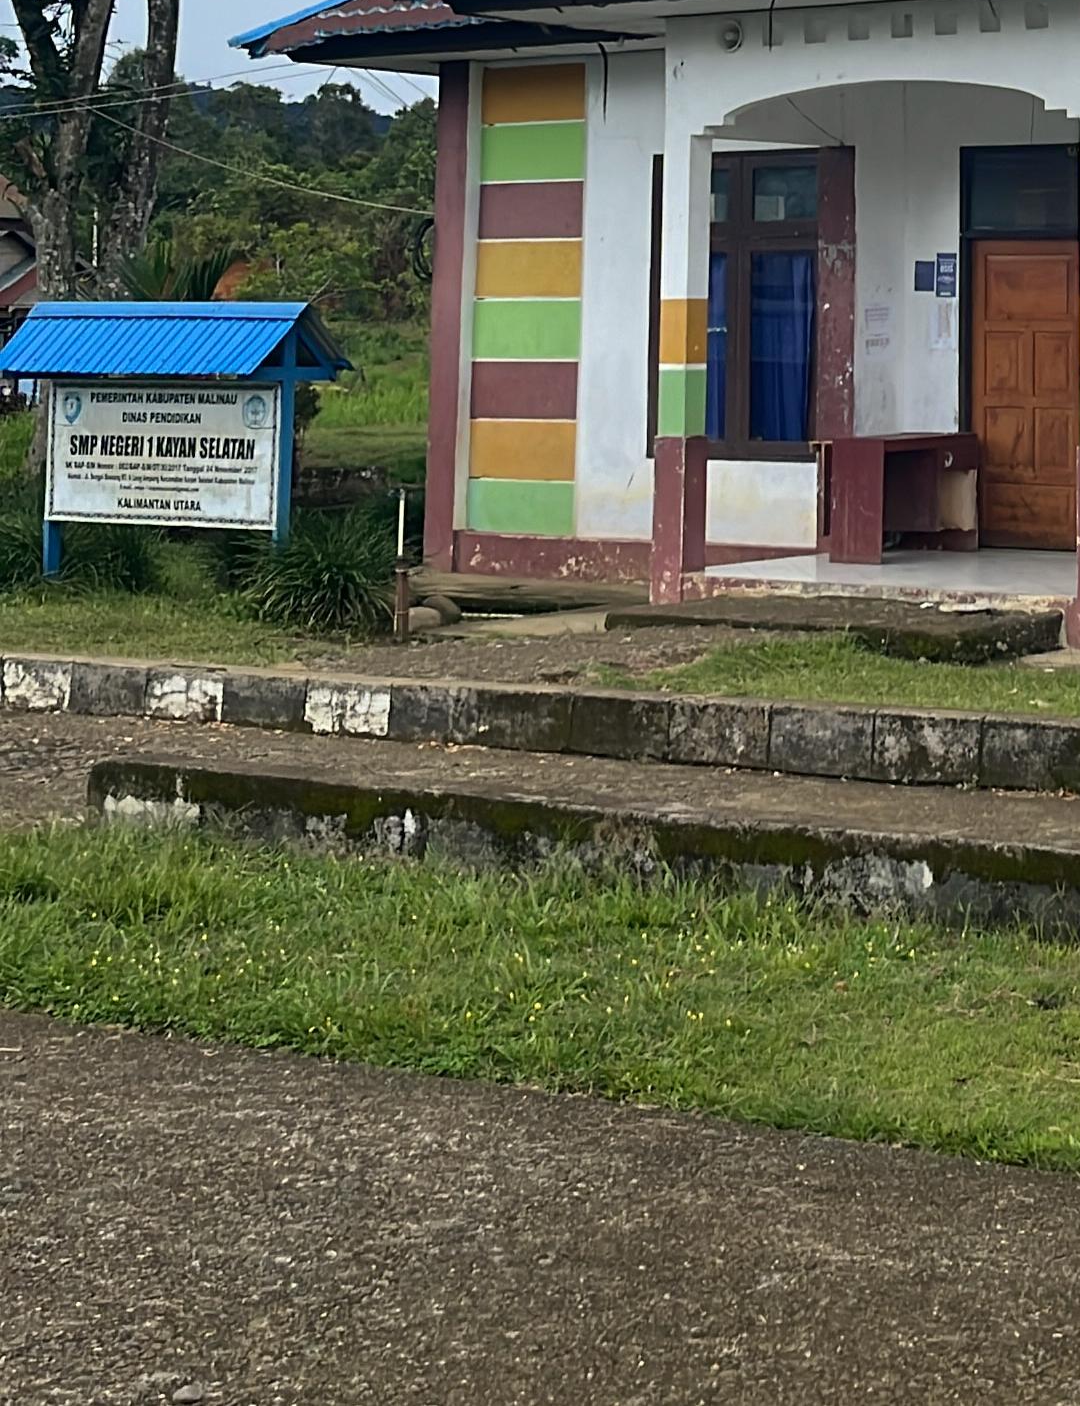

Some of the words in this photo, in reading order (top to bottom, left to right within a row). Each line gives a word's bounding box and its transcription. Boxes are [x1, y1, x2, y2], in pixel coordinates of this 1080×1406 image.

[91, 392, 144, 404] PEMERINTAH
[146, 392, 195, 404] KABUPATEN
[198, 393, 238, 405] MALINAU
[122, 412, 147, 423] DINAS
[149, 412, 202, 424] PENDIDIKAN
[70, 435, 98, 456] SMP
[100, 435, 144, 457] NEGERI
[147, 436, 153, 458] 1
[156, 436, 197, 458] KAYAN
[199, 437, 256, 460] SELATAN
[117, 497, 171, 510] KALIMANTAN
[173, 499, 202, 511] UTARA
